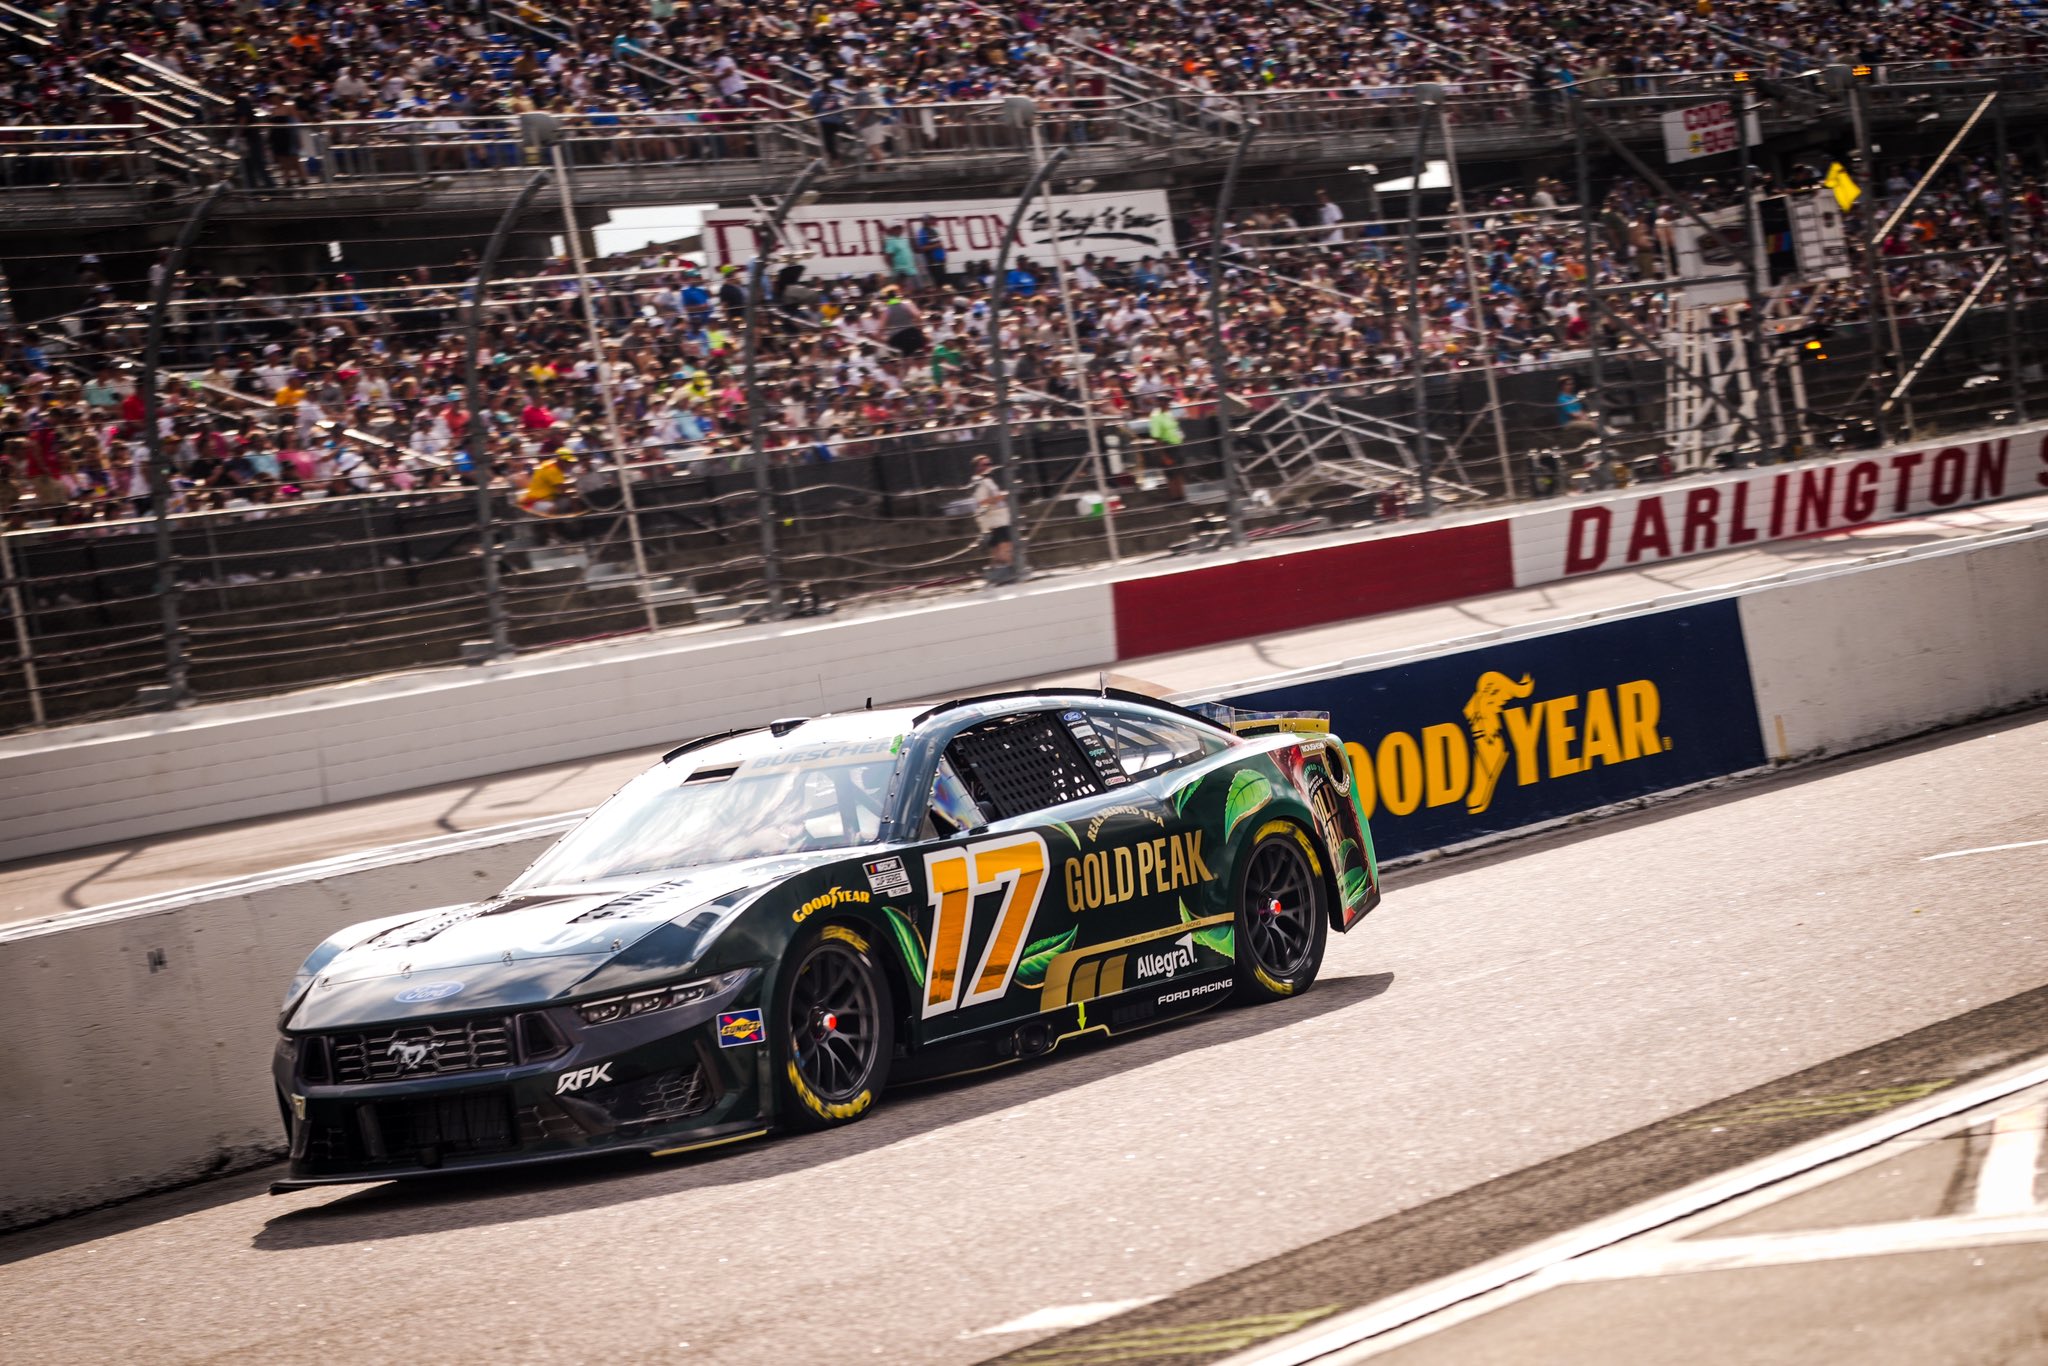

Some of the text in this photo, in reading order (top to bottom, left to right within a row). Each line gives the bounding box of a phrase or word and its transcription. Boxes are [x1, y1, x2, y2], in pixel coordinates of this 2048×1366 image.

[706, 214, 1027, 272] DRLITON
[1564, 438, 2010, 576] DARLINGTON
[1099, 805, 1140, 819] BREWED
[1140, 808, 1164, 828] TEA
[1065, 846, 1135, 913] GOLD
[1136, 829, 1214, 897] PEAK
[792, 886, 871, 923] GOODYEAR
[922, 831, 1051, 1020] 17
[1137, 947, 1191, 978] Allegra
[1158, 990, 1190, 1005] FORD
[1192, 978, 1233, 997] RACING
[722, 1020, 762, 1036] SUNOCO
[554, 1061, 614, 1096] RFK
